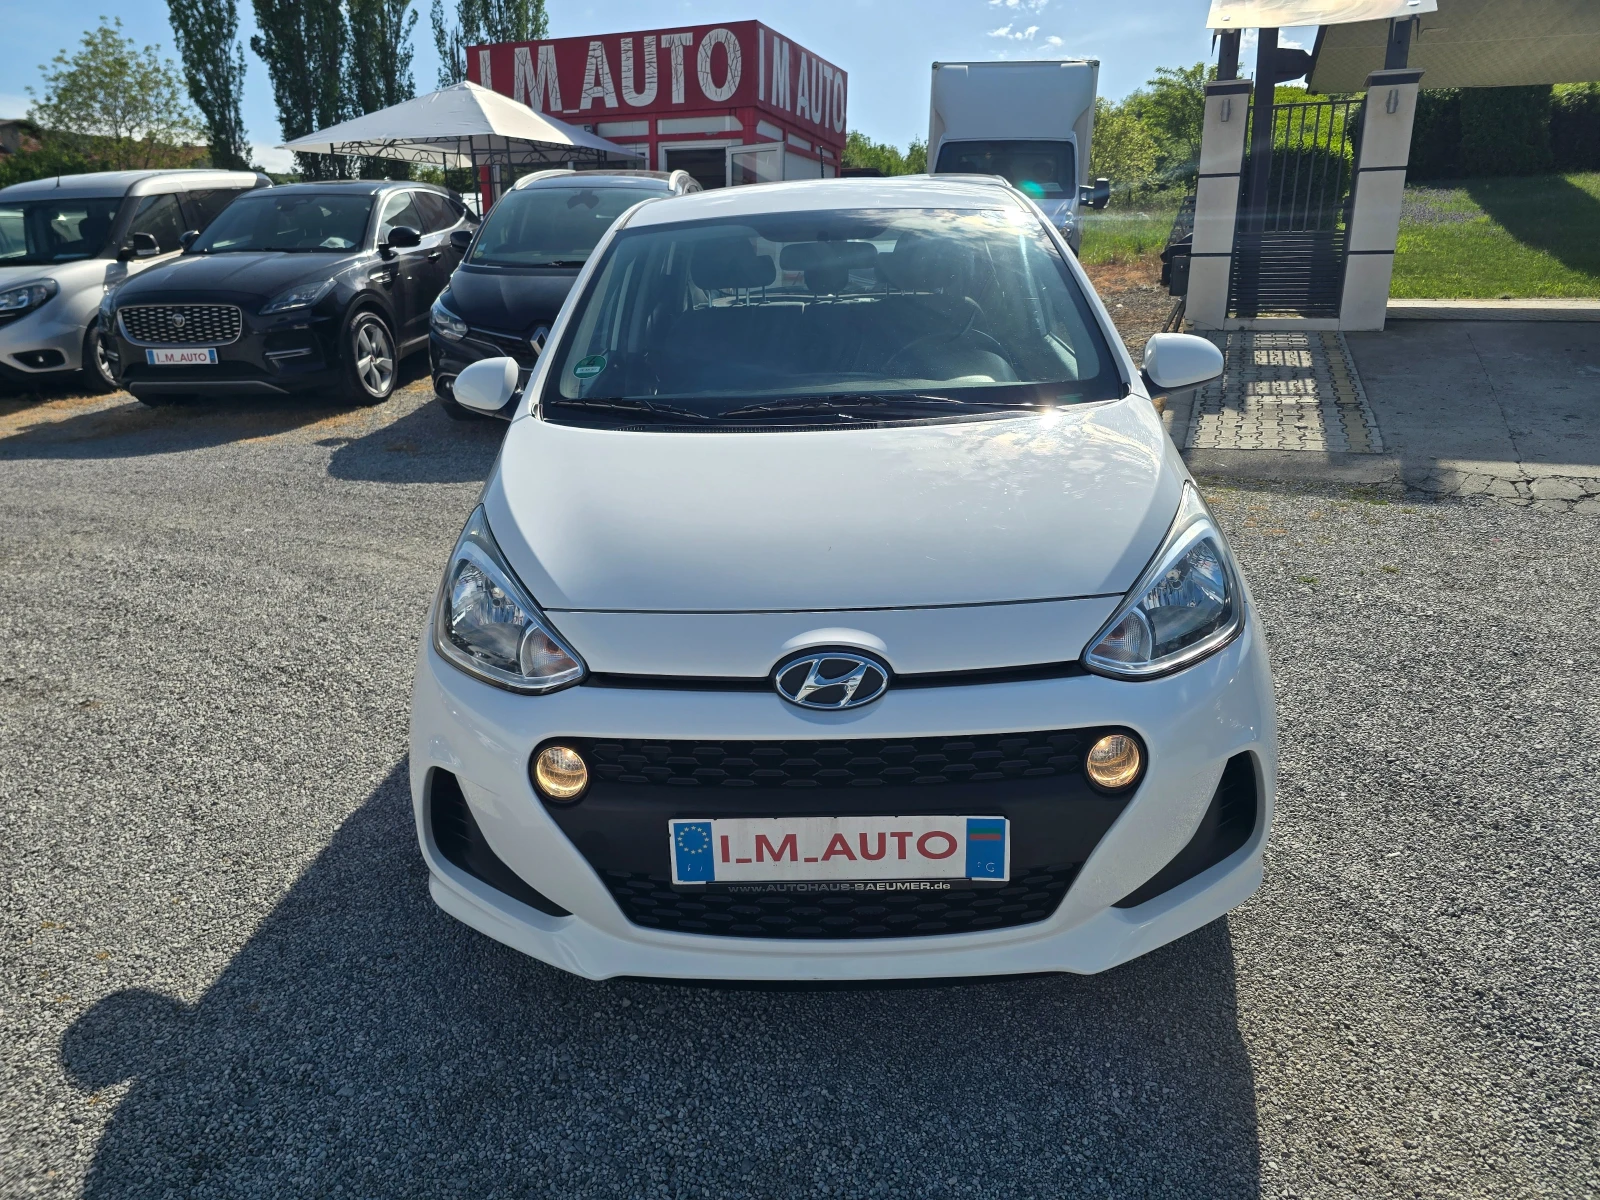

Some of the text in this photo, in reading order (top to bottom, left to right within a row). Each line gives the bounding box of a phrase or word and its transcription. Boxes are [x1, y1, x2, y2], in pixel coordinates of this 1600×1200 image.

[796, 51, 845, 134] AUTO
[156, 353, 207, 363] I_M_AUTO
[720, 830, 958, 864] I_M_AUTO
[728, 881, 951, 893] www.AUTOHAUS-BAEUMER.de
